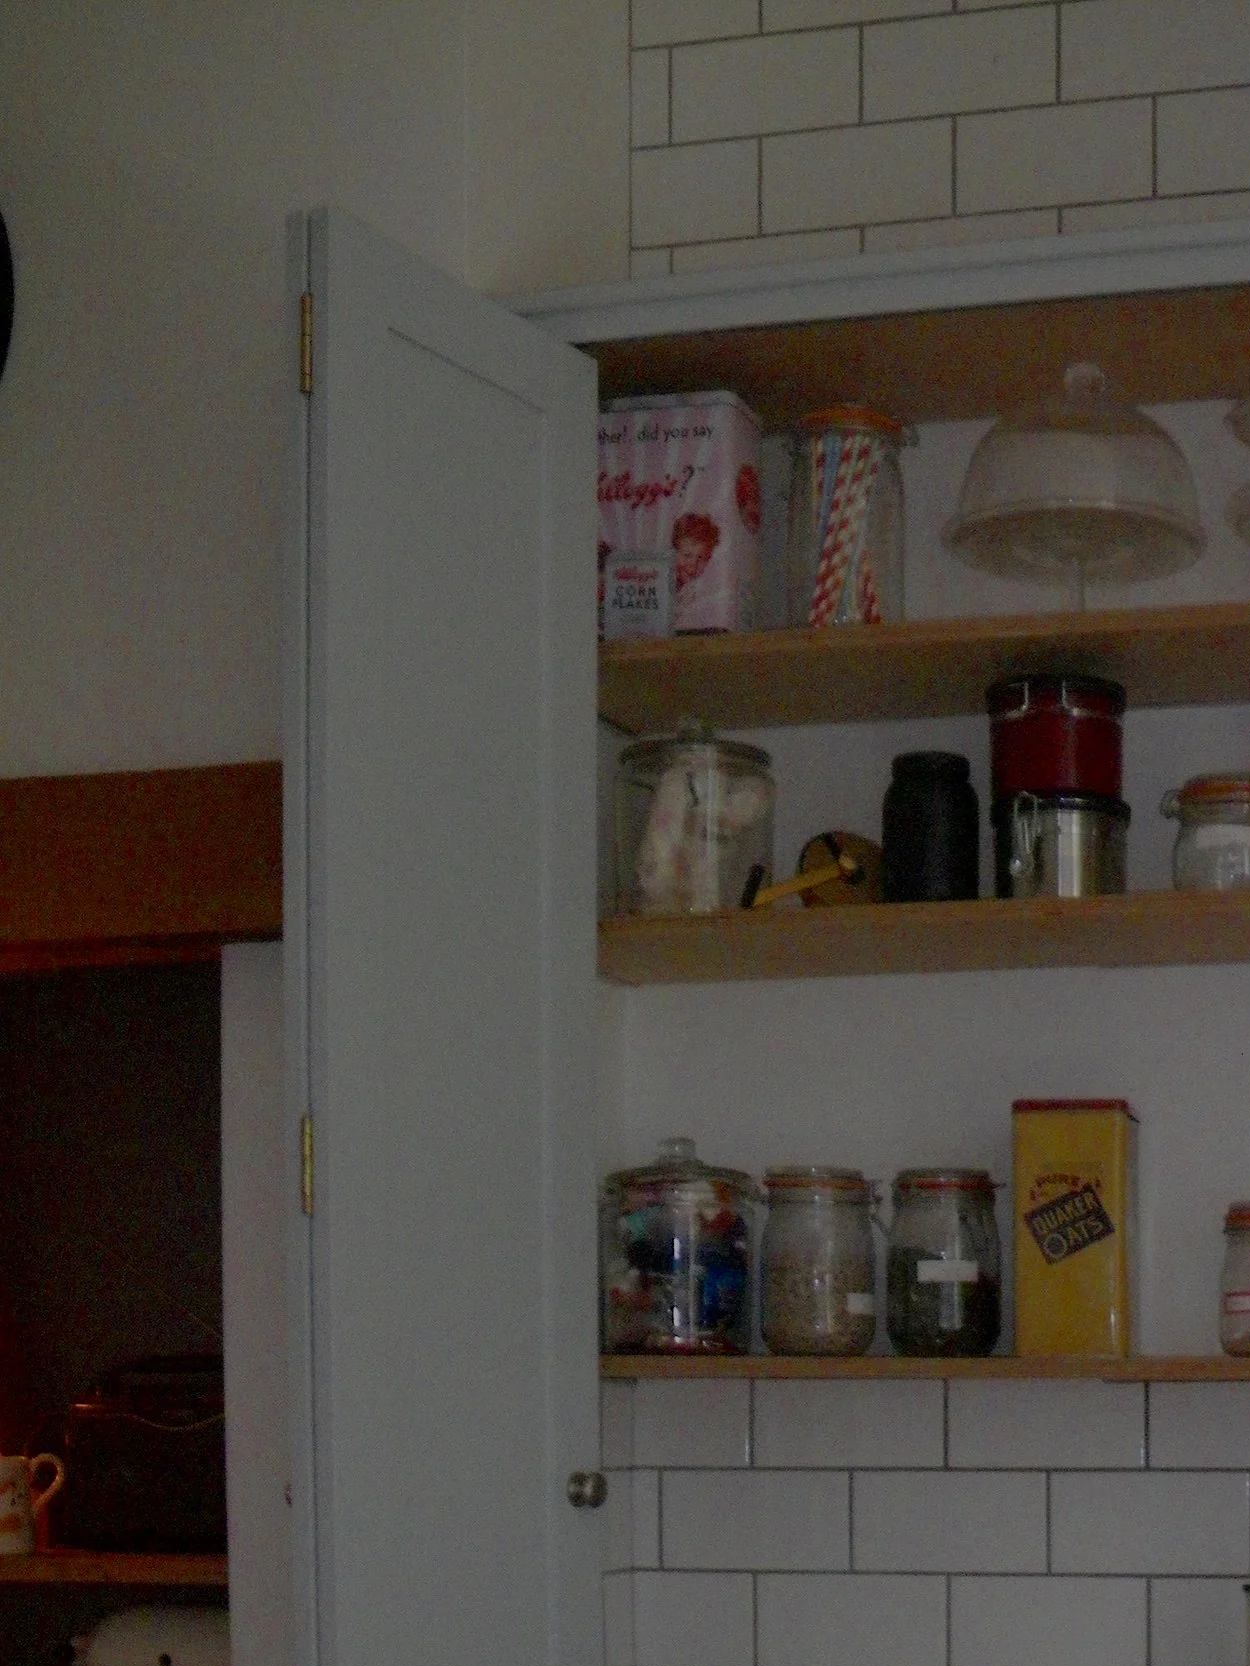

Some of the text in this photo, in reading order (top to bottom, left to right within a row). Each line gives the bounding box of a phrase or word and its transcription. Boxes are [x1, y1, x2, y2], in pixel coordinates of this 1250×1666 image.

[662, 427, 689, 442] you
[692, 425, 714, 439] say
[615, 584, 656, 597] CORN
[611, 597, 659, 610] FLAKES
[1032, 1191, 1101, 1235] QUAKER
[1044, 1216, 1105, 1260] OATS
